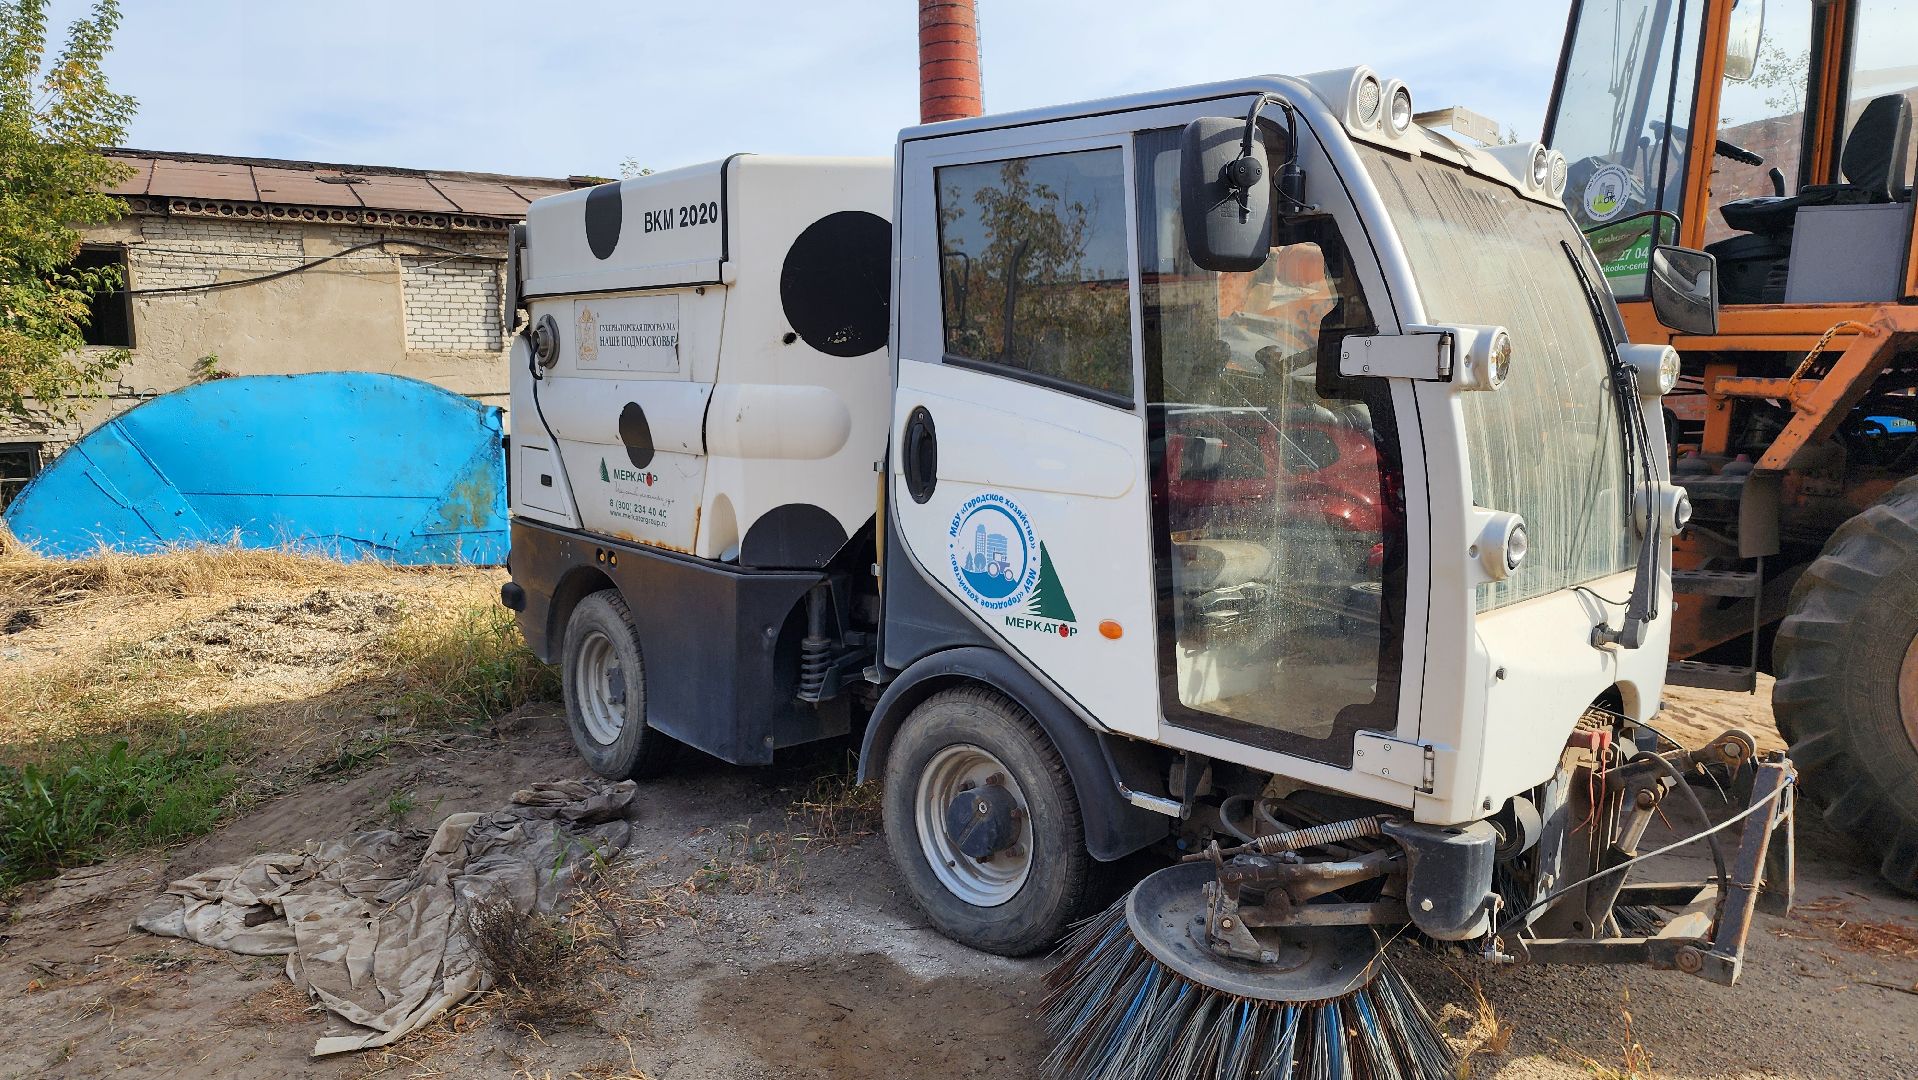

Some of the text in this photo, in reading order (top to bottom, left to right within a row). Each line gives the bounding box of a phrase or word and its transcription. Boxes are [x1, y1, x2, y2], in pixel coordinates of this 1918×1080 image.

[644, 201, 718, 233] ВКМ 2020
[599, 335, 676, 349] НАШЕ ПОДМОСКОВЬЕ
[609, 498, 614, 507] 8
[949, 493, 1037, 549] МБУ «Городское хозяйство»
[1025, 568, 1037, 593] МБУ
[980, 591, 1024, 610] «Городское
[1005, 615, 1078, 638] МЕРКАТОР
